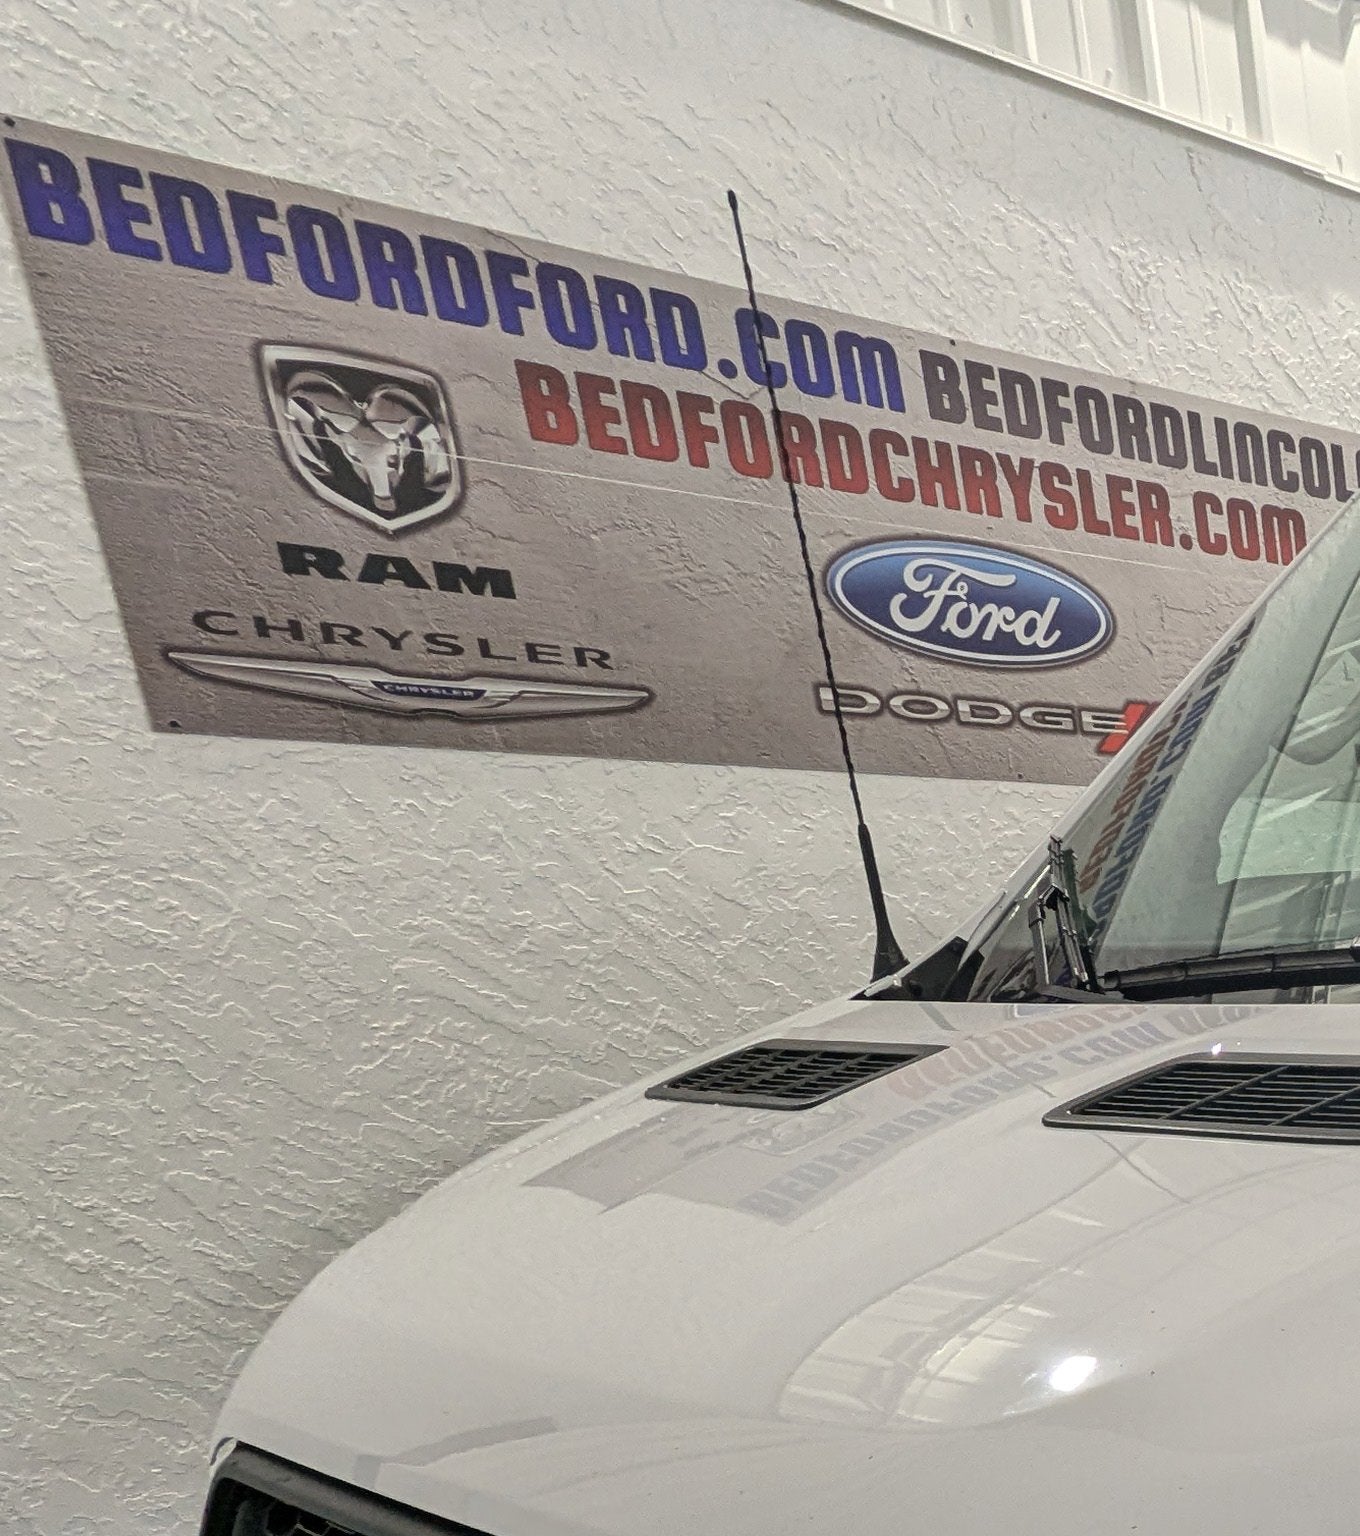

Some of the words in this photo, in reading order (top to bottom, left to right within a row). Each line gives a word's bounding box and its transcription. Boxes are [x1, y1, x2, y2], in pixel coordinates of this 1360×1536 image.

[6, 137, 906, 413] BEDFORDFORD.COM
[514, 358, 1308, 567] BEDFORDCHRYSLER.COM
[275, 540, 517, 600] RAM
[889, 557, 1062, 649] Ford
[191, 609, 612, 671] CHRYSLER
[818, 686, 1130, 735] DODGE
